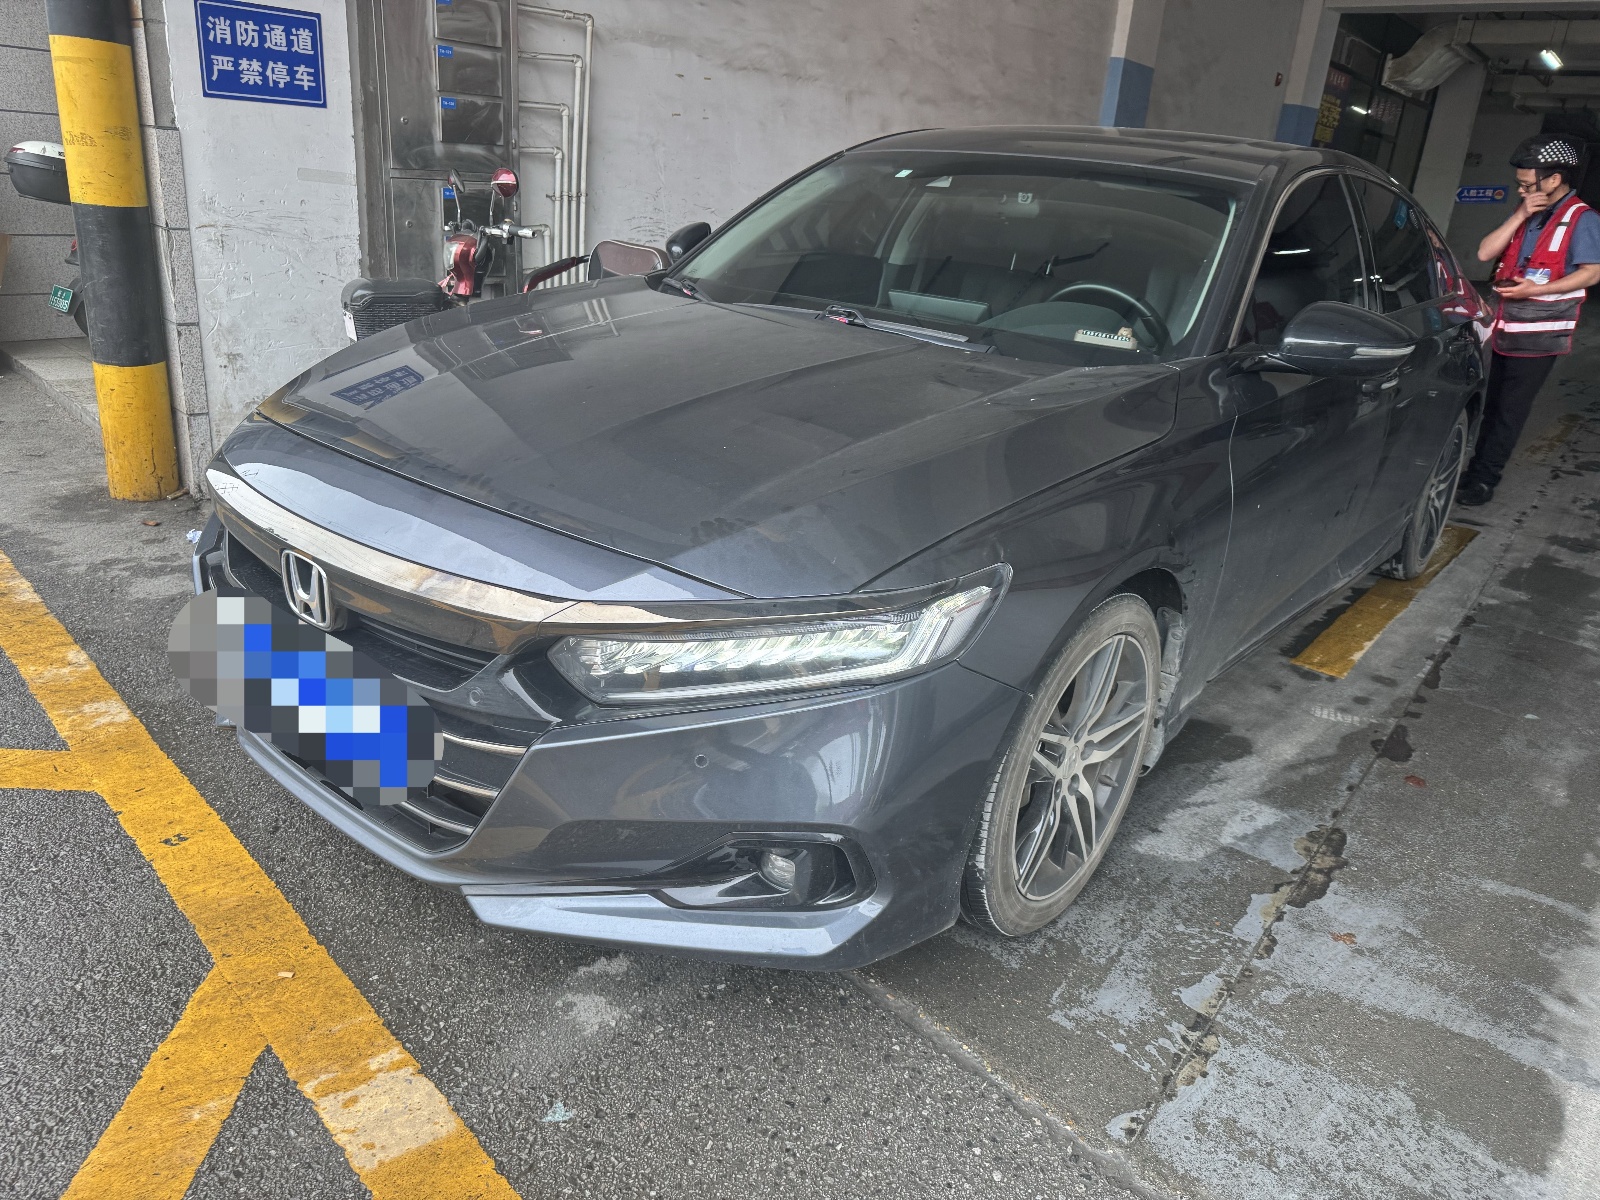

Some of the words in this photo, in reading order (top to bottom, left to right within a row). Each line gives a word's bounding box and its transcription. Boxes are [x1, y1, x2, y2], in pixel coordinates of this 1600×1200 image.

[206, 16, 315, 55] 消防通道
[210, 55, 316, 91] 严禁停车
